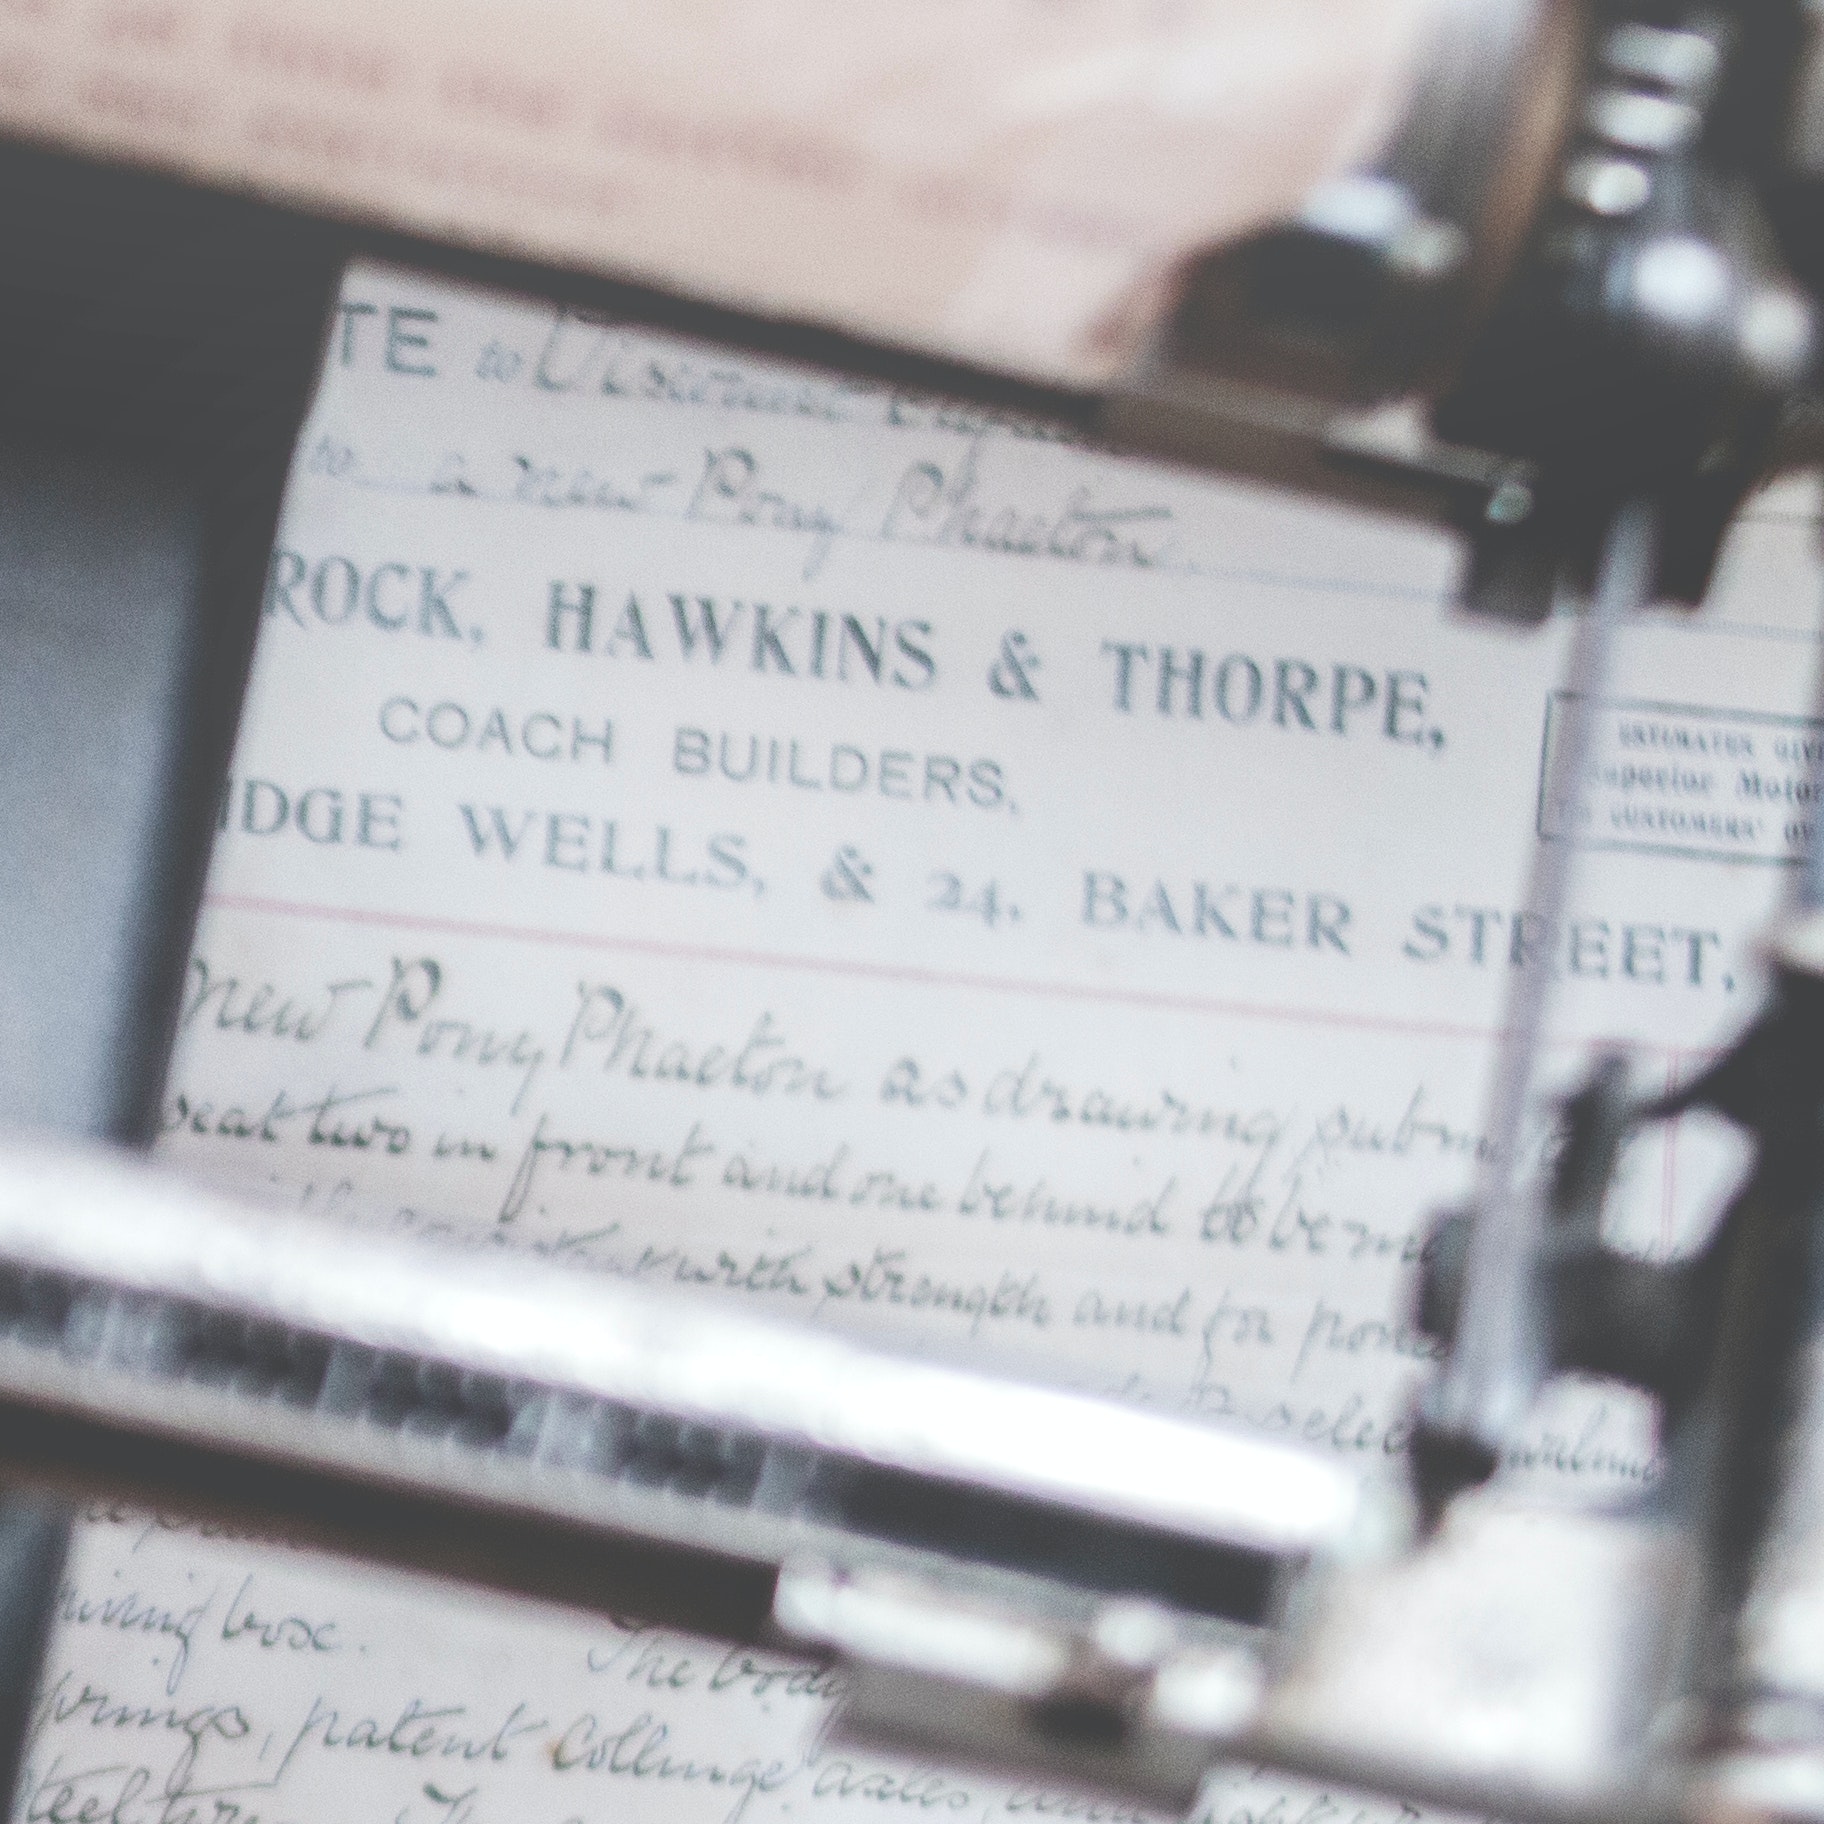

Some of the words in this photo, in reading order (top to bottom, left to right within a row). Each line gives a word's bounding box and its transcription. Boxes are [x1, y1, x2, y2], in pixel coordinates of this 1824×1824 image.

[377, 696, 614, 763] COACH
[546, 579, 936, 690] HAWKINS
[987, 628, 1042, 705] &
[1099, 638, 1447, 758] THORPE,
[459, 802, 766, 898] WELLS,
[819, 845, 876, 905] &
[1080, 868, 1354, 957] BAKER
